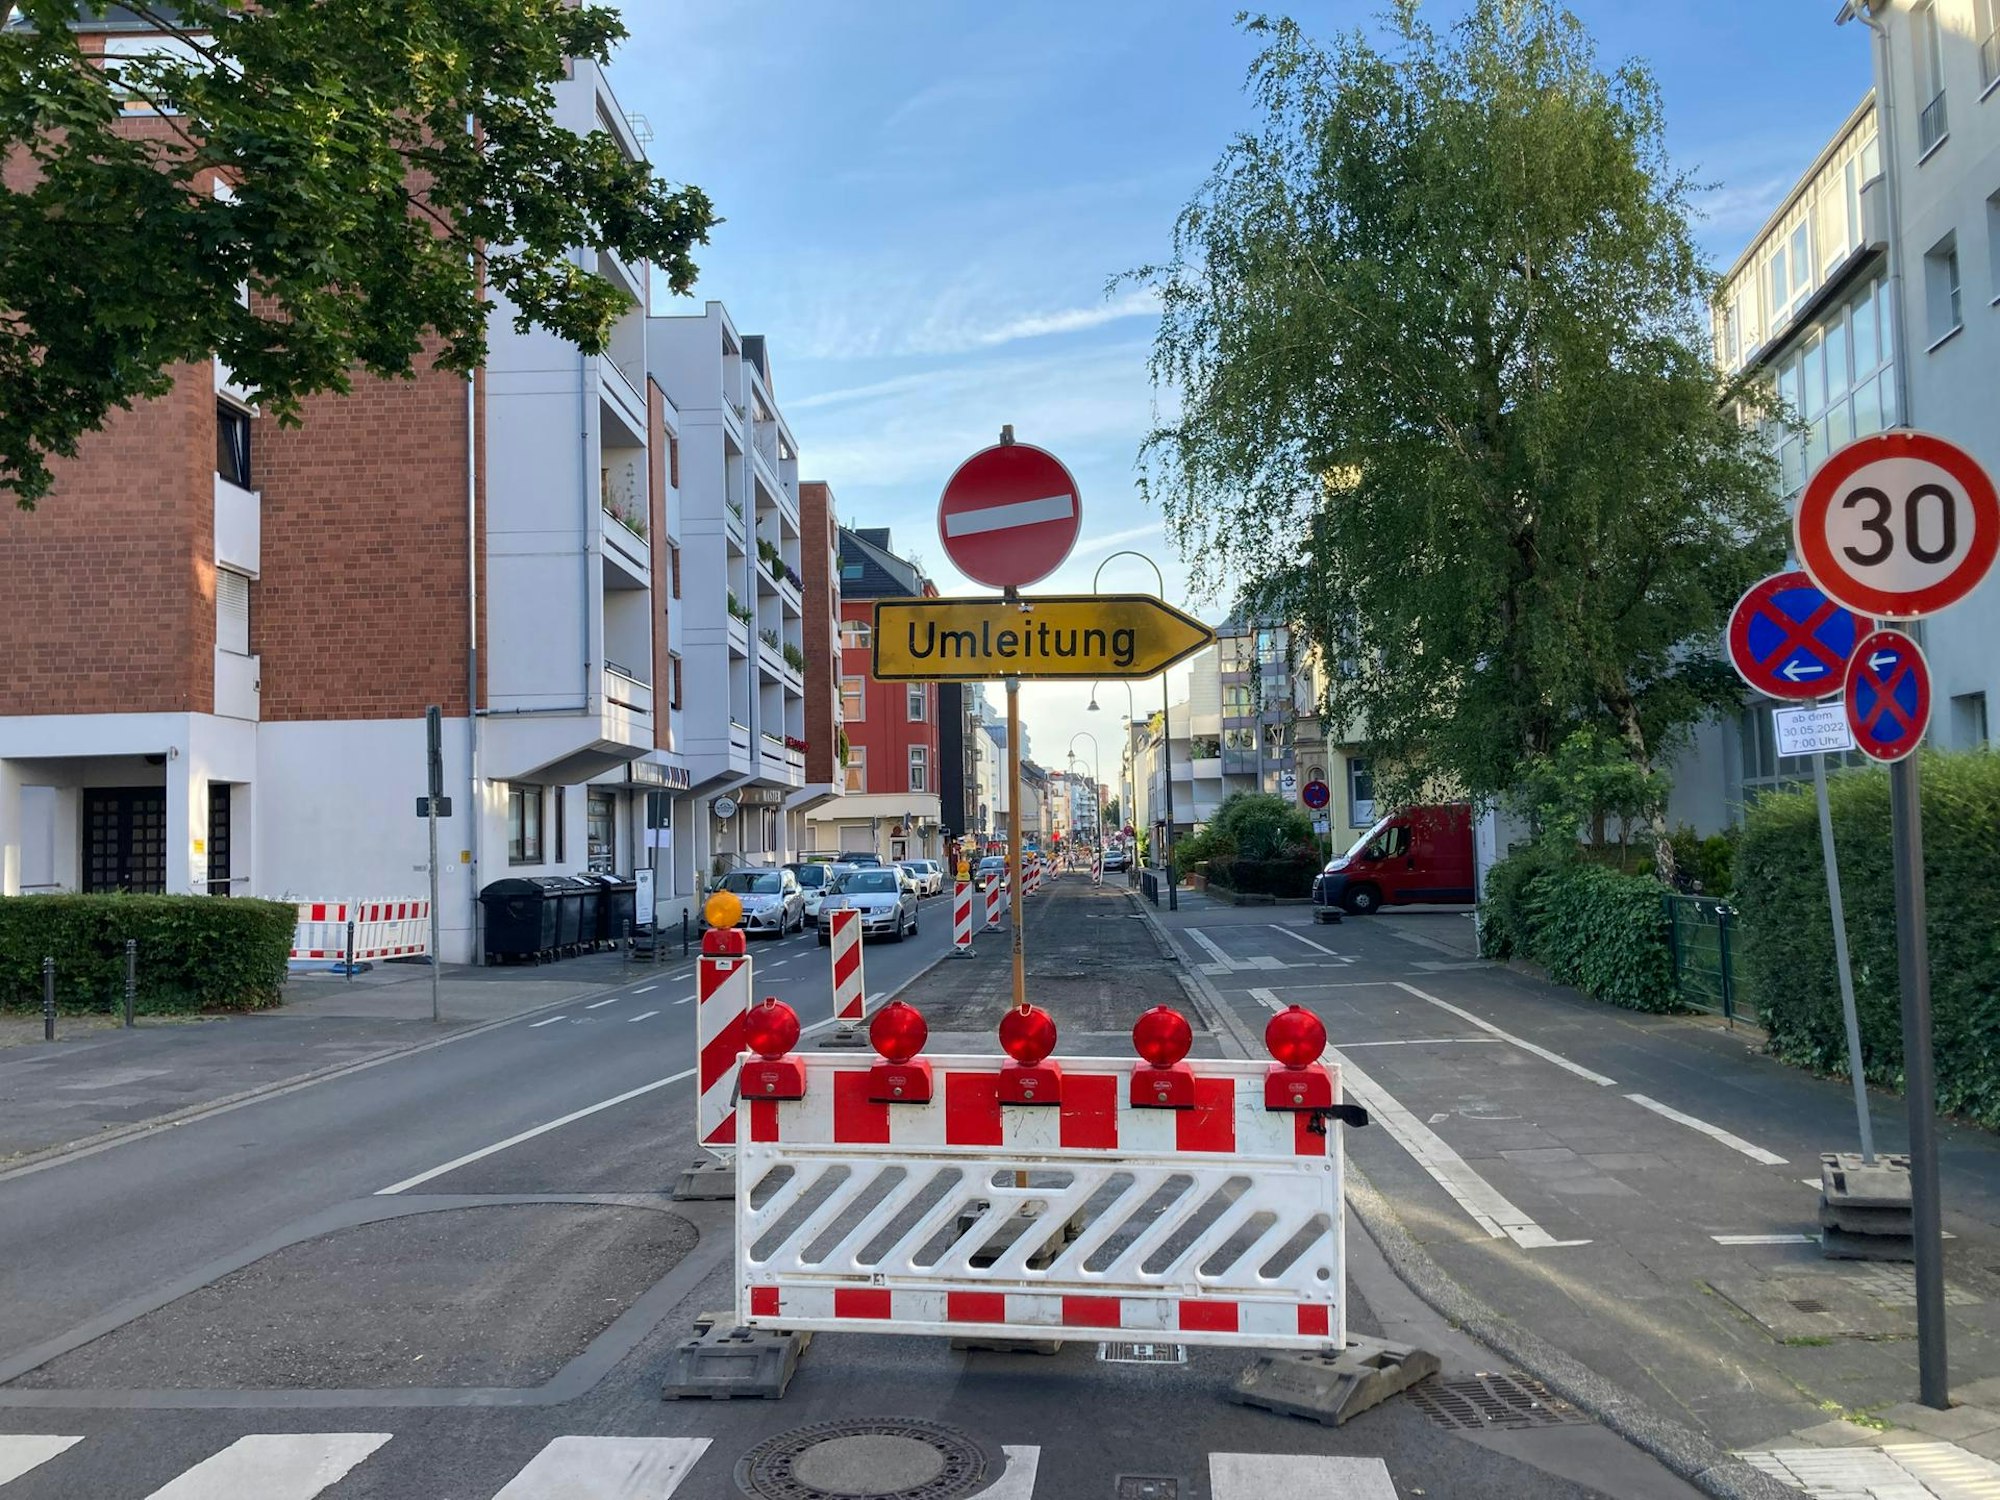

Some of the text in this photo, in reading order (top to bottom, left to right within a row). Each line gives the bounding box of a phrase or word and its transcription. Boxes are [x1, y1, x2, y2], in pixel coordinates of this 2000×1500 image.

[1842, 484, 1956, 566] 30
[908, 619, 1135, 667] Umleitung
[1792, 712, 1832, 723] ab dem
[1784, 722, 1844, 737] 30.05.2022
[1792, 736, 1840, 749] 7:00 Uhr
